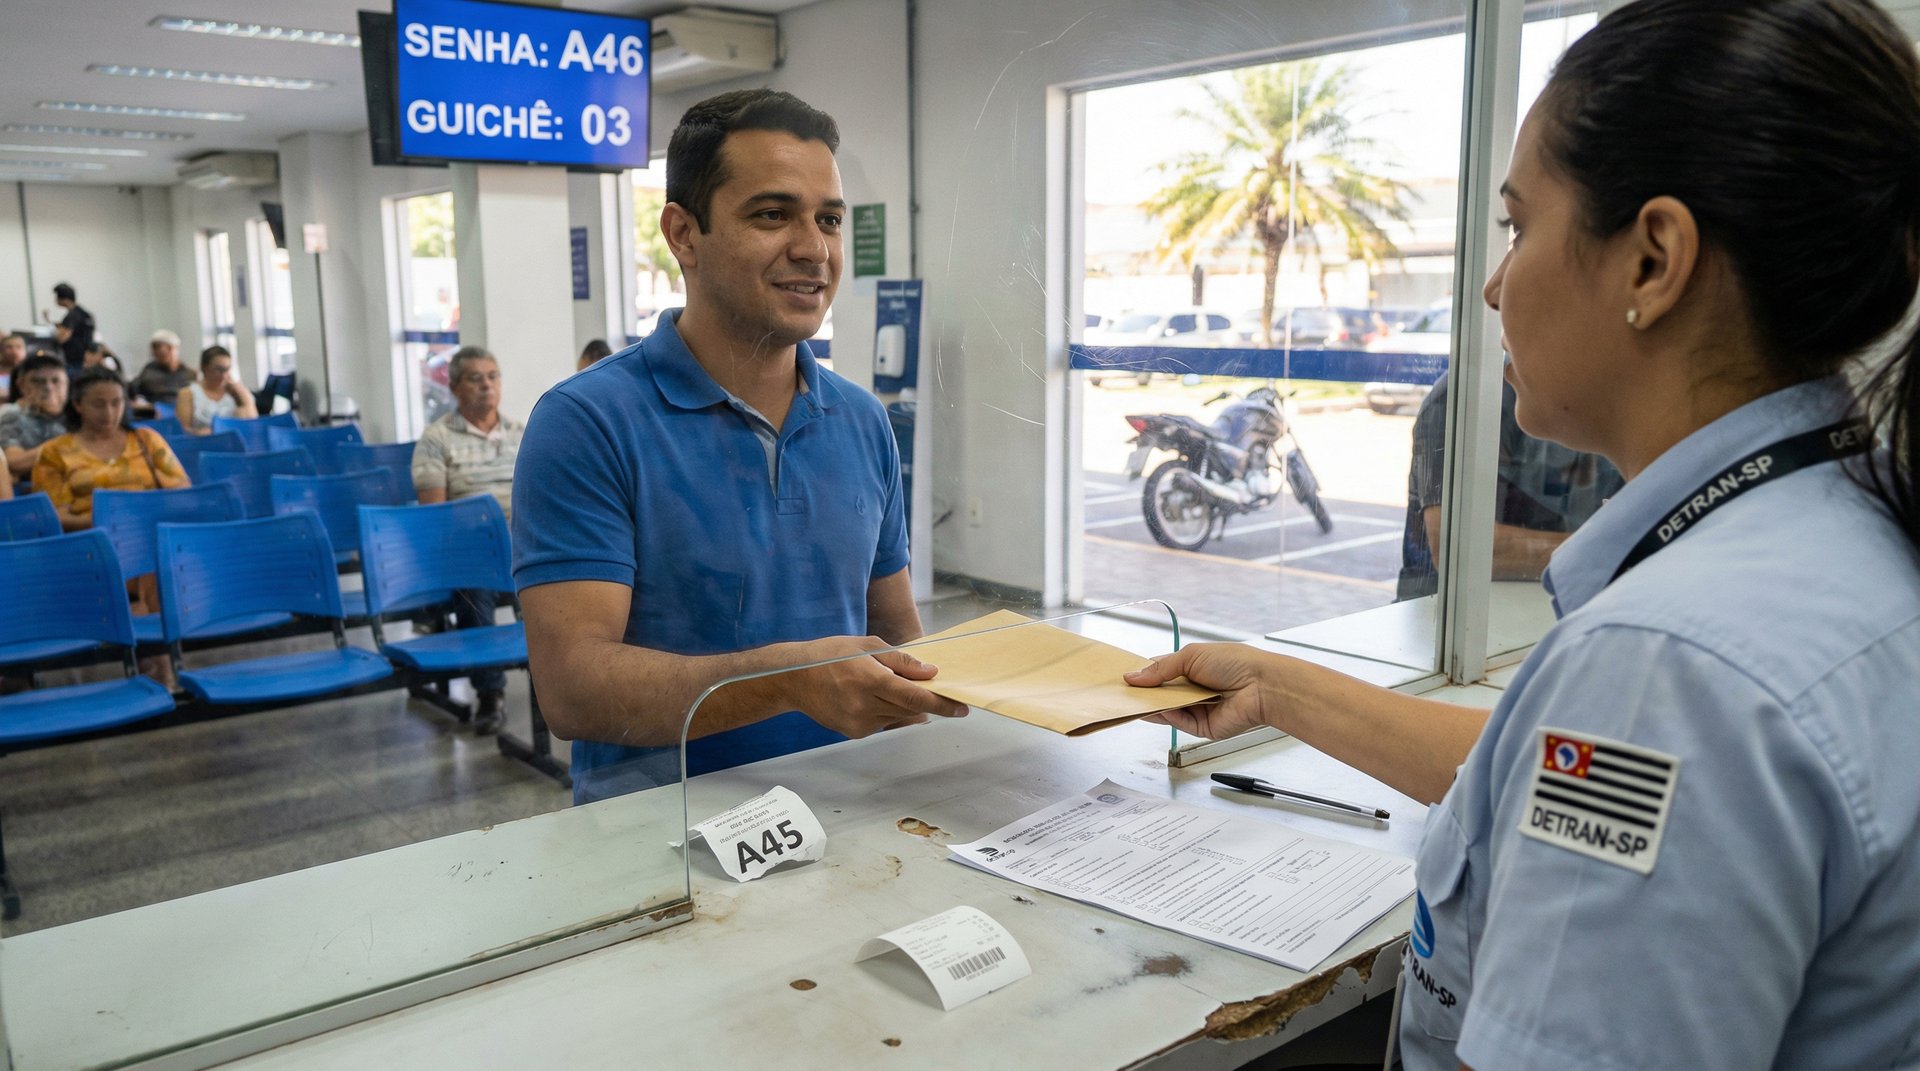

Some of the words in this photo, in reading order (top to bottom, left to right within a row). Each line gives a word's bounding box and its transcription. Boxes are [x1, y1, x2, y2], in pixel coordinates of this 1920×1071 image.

[404, 23, 549, 68] SENHA:
[558, 29, 644, 77] A46
[406, 99, 563, 141] GUICHÊ:
[580, 104, 632, 147] 03
[1656, 454, 1773, 543] DETRAN-SP
[736, 819, 804, 875] A45
[1531, 806, 1648, 857] DETRAN-SP
[1408, 947, 1457, 1009] RAN-SP
